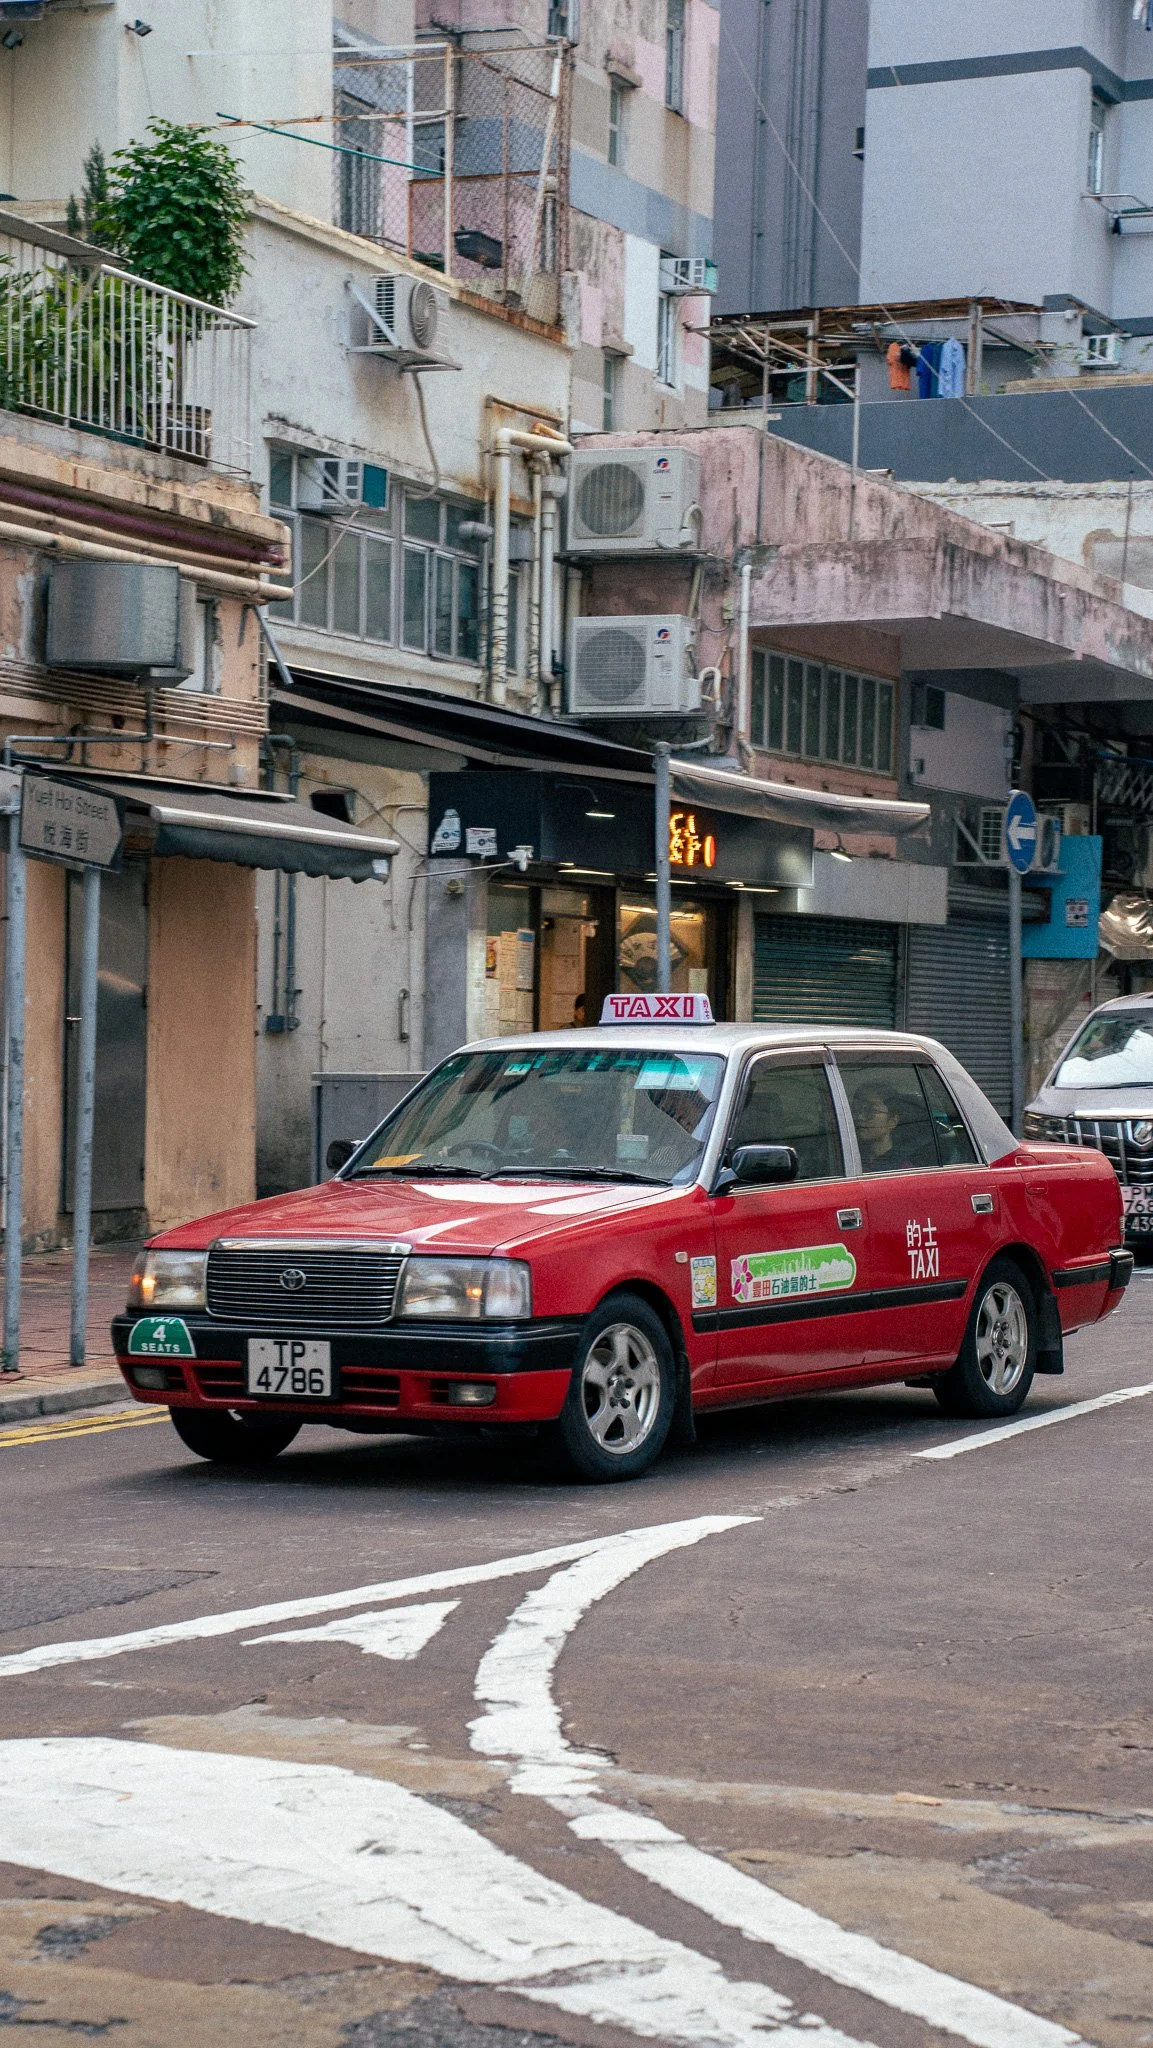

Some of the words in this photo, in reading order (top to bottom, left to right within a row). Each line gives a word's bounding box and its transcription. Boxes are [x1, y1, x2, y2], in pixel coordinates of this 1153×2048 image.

[27, 782, 53, 806] Yuet
[56, 790, 74, 810] Hoi
[76, 796, 109, 821] Street
[609, 996, 695, 1018] TAXI
[906, 1217, 938, 1248] 的士
[907, 1247, 939, 1279] TAXI
[152, 1325, 166, 1341] 4
[141, 1343, 180, 1352] SEATS
[273, 1340, 306, 1367] TP
[257, 1366, 324, 1394] 4786
